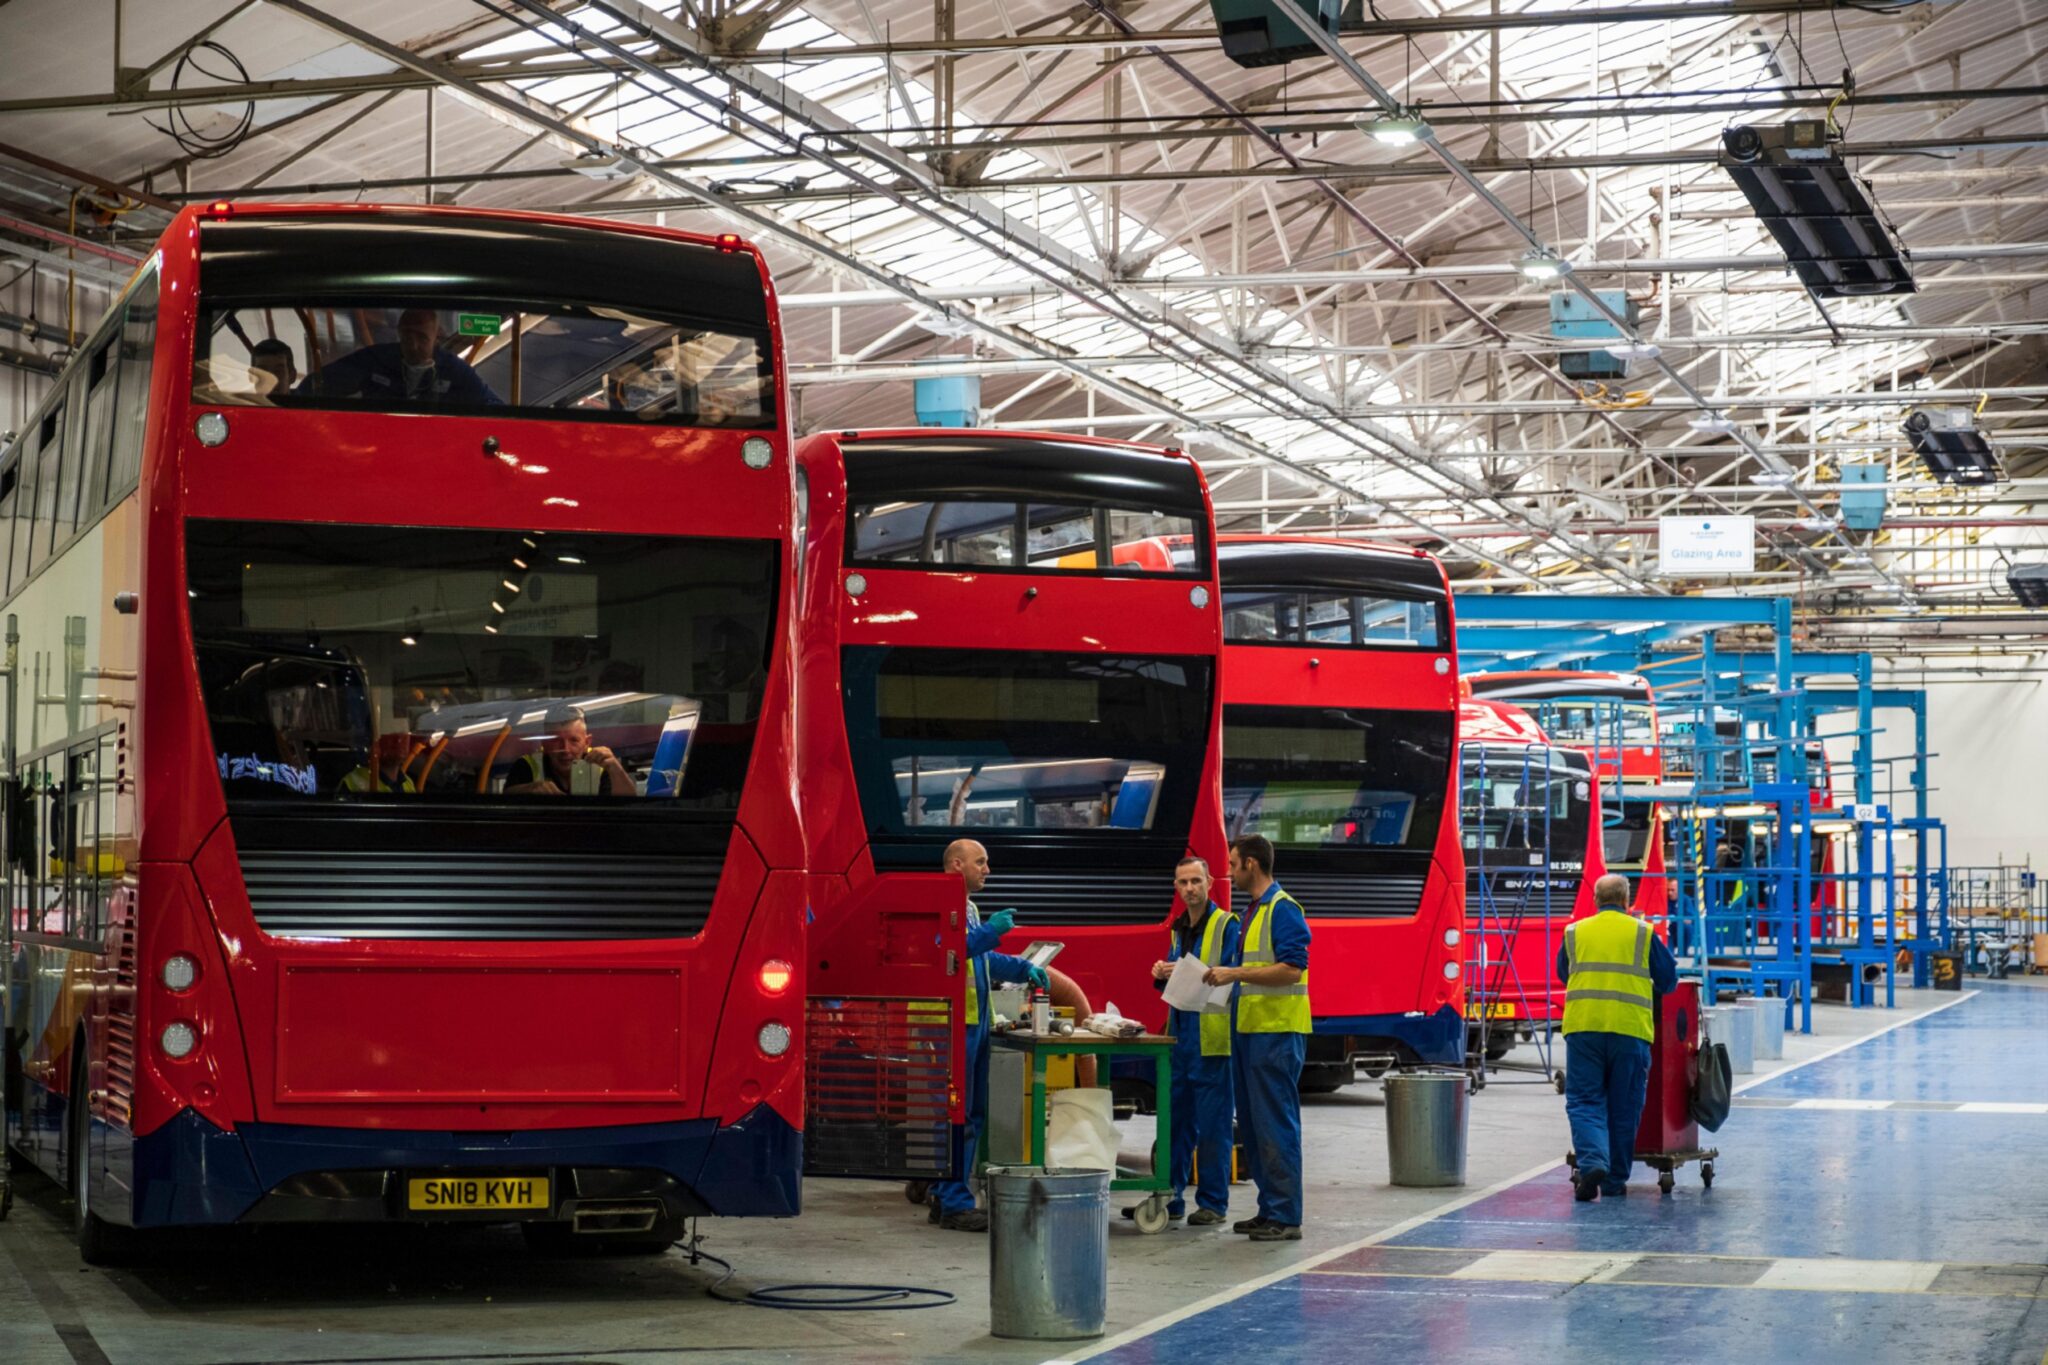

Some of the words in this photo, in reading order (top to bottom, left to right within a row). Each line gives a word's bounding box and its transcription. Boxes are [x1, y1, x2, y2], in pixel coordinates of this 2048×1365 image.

[1671, 548, 1713, 560] Glazing
[1717, 548, 1742, 558] Area
[425, 1182, 477, 1204] SN18
[486, 1182, 532, 1204] KVH
